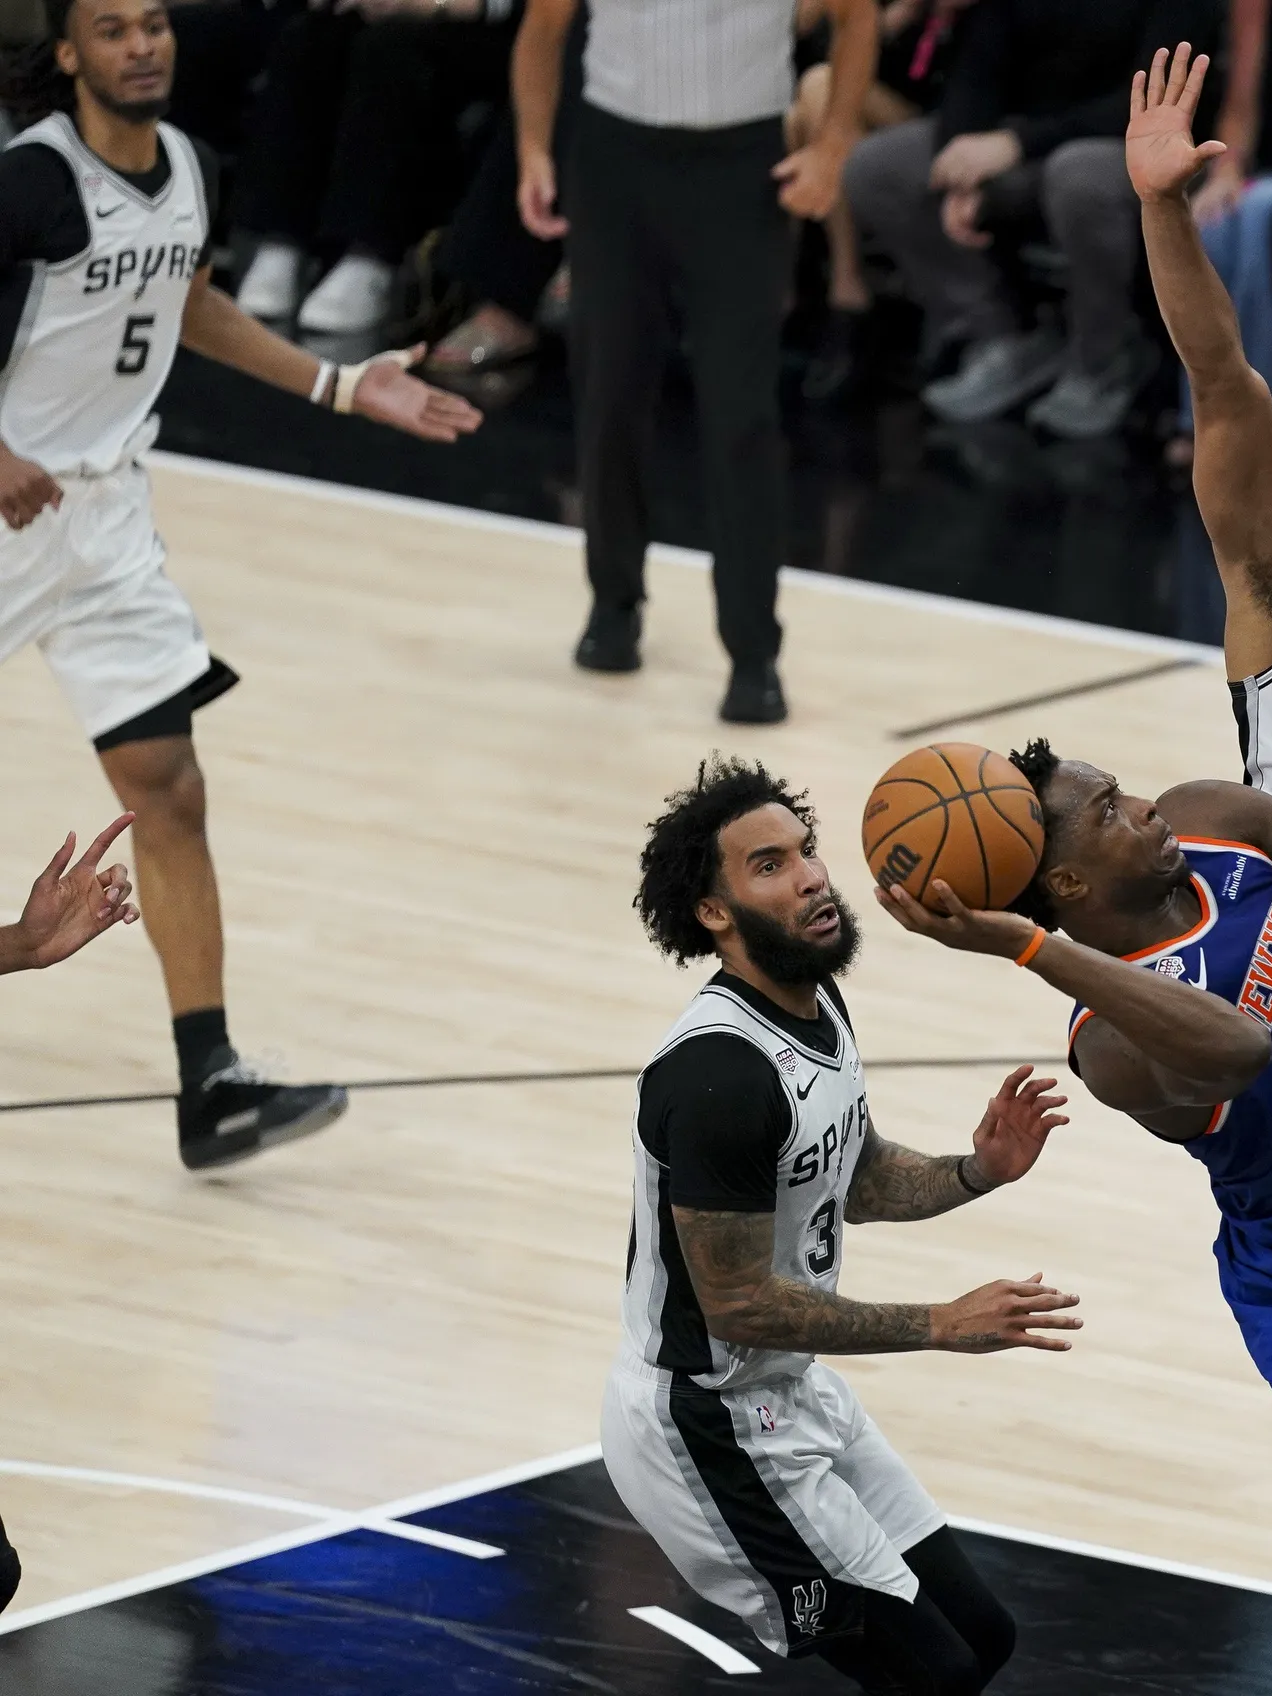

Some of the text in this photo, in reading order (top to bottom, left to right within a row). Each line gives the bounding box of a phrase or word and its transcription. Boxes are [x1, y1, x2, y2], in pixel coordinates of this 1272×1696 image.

[83, 242, 201, 300] SPURS
[115, 314, 156, 375] 5
[776, 1050, 793, 1061] USA
[788, 1091, 868, 1188] SPUR
